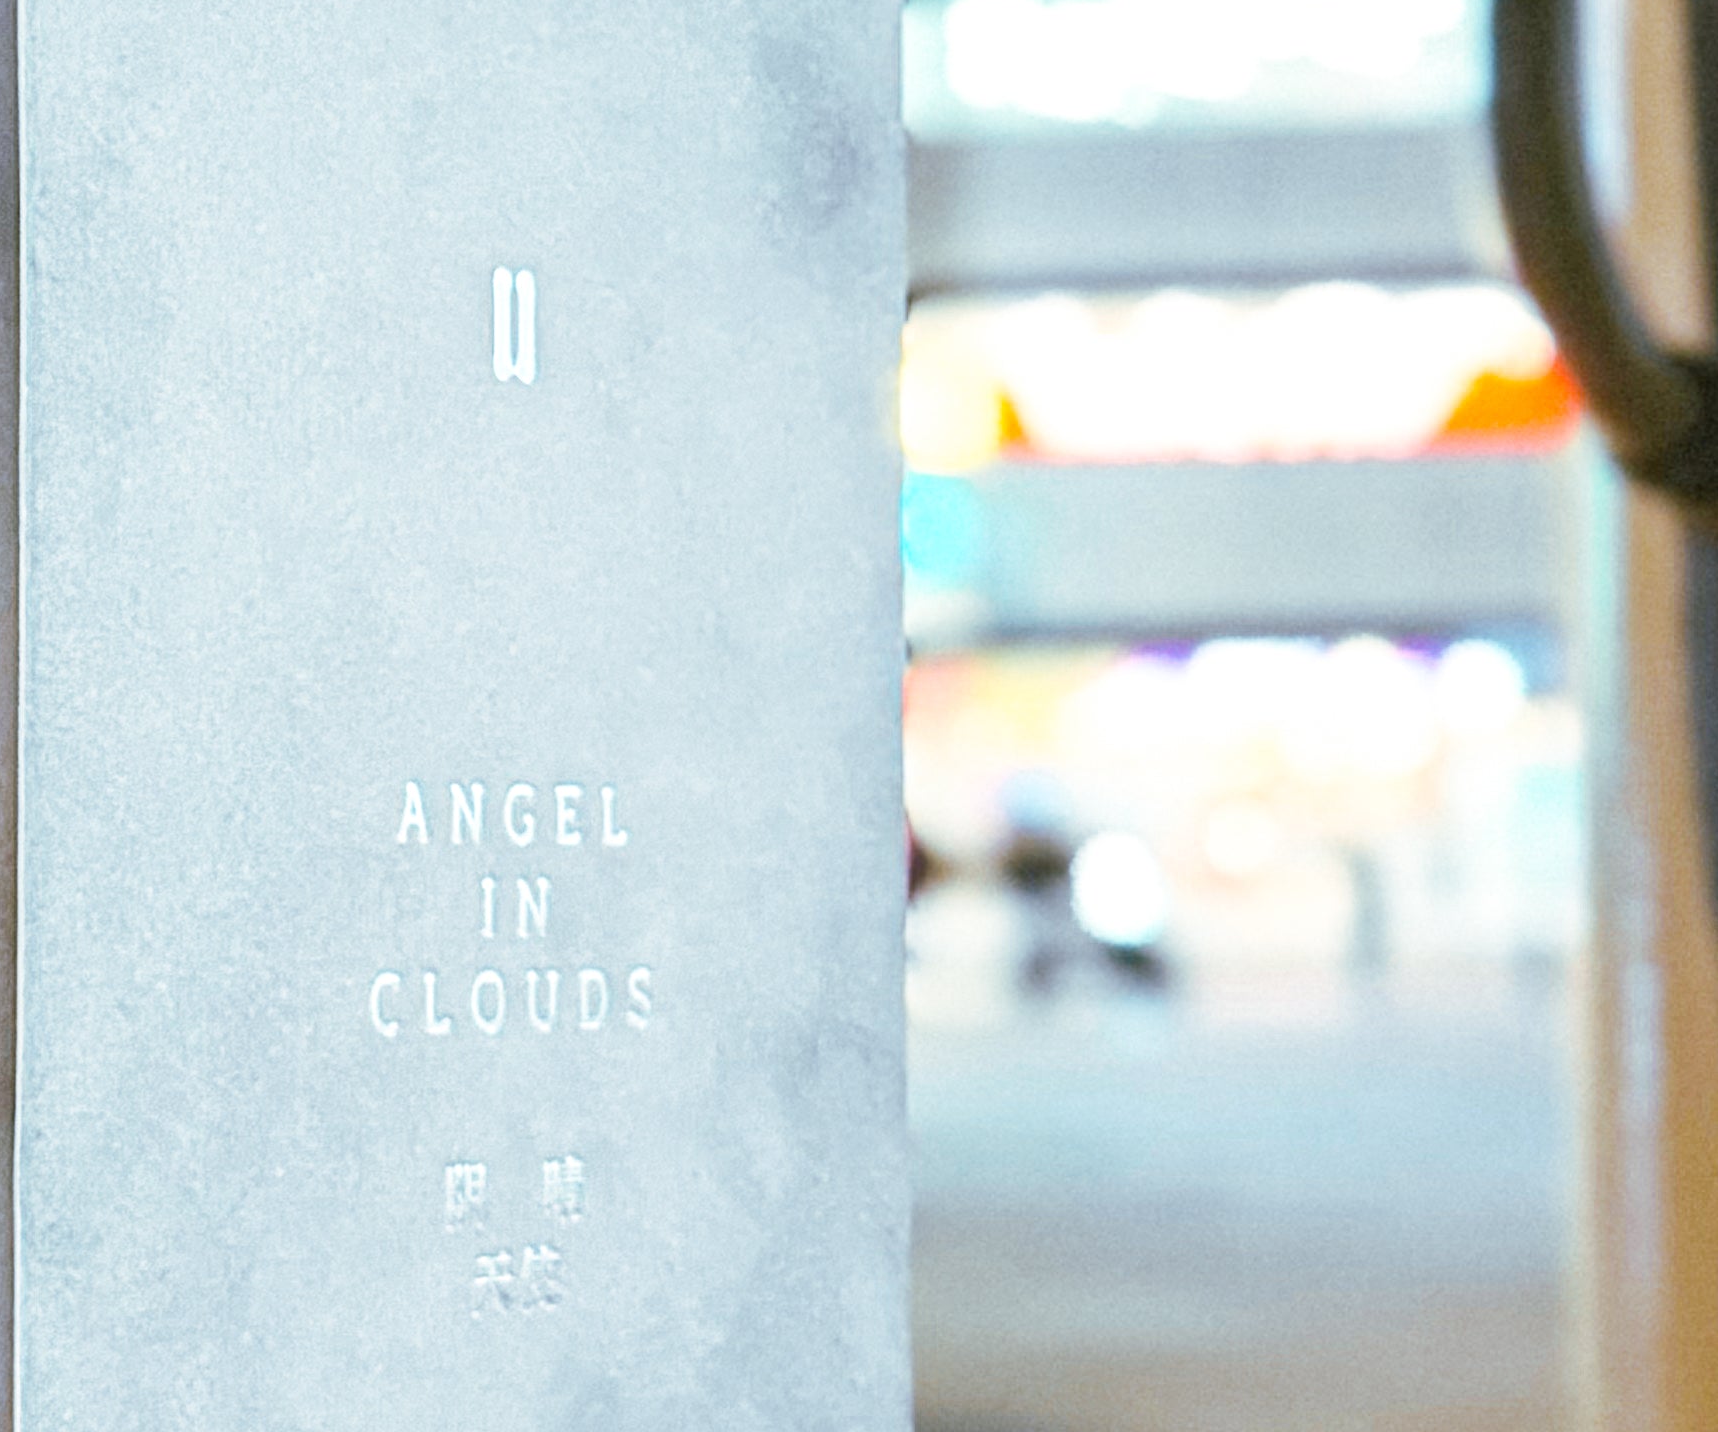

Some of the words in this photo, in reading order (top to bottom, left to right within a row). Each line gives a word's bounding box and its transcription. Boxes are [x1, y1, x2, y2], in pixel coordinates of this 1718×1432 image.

[396, 780, 629, 847] ANGEL
[480, 876, 551, 939] IN
[369, 966, 652, 1038] CLOUDS
